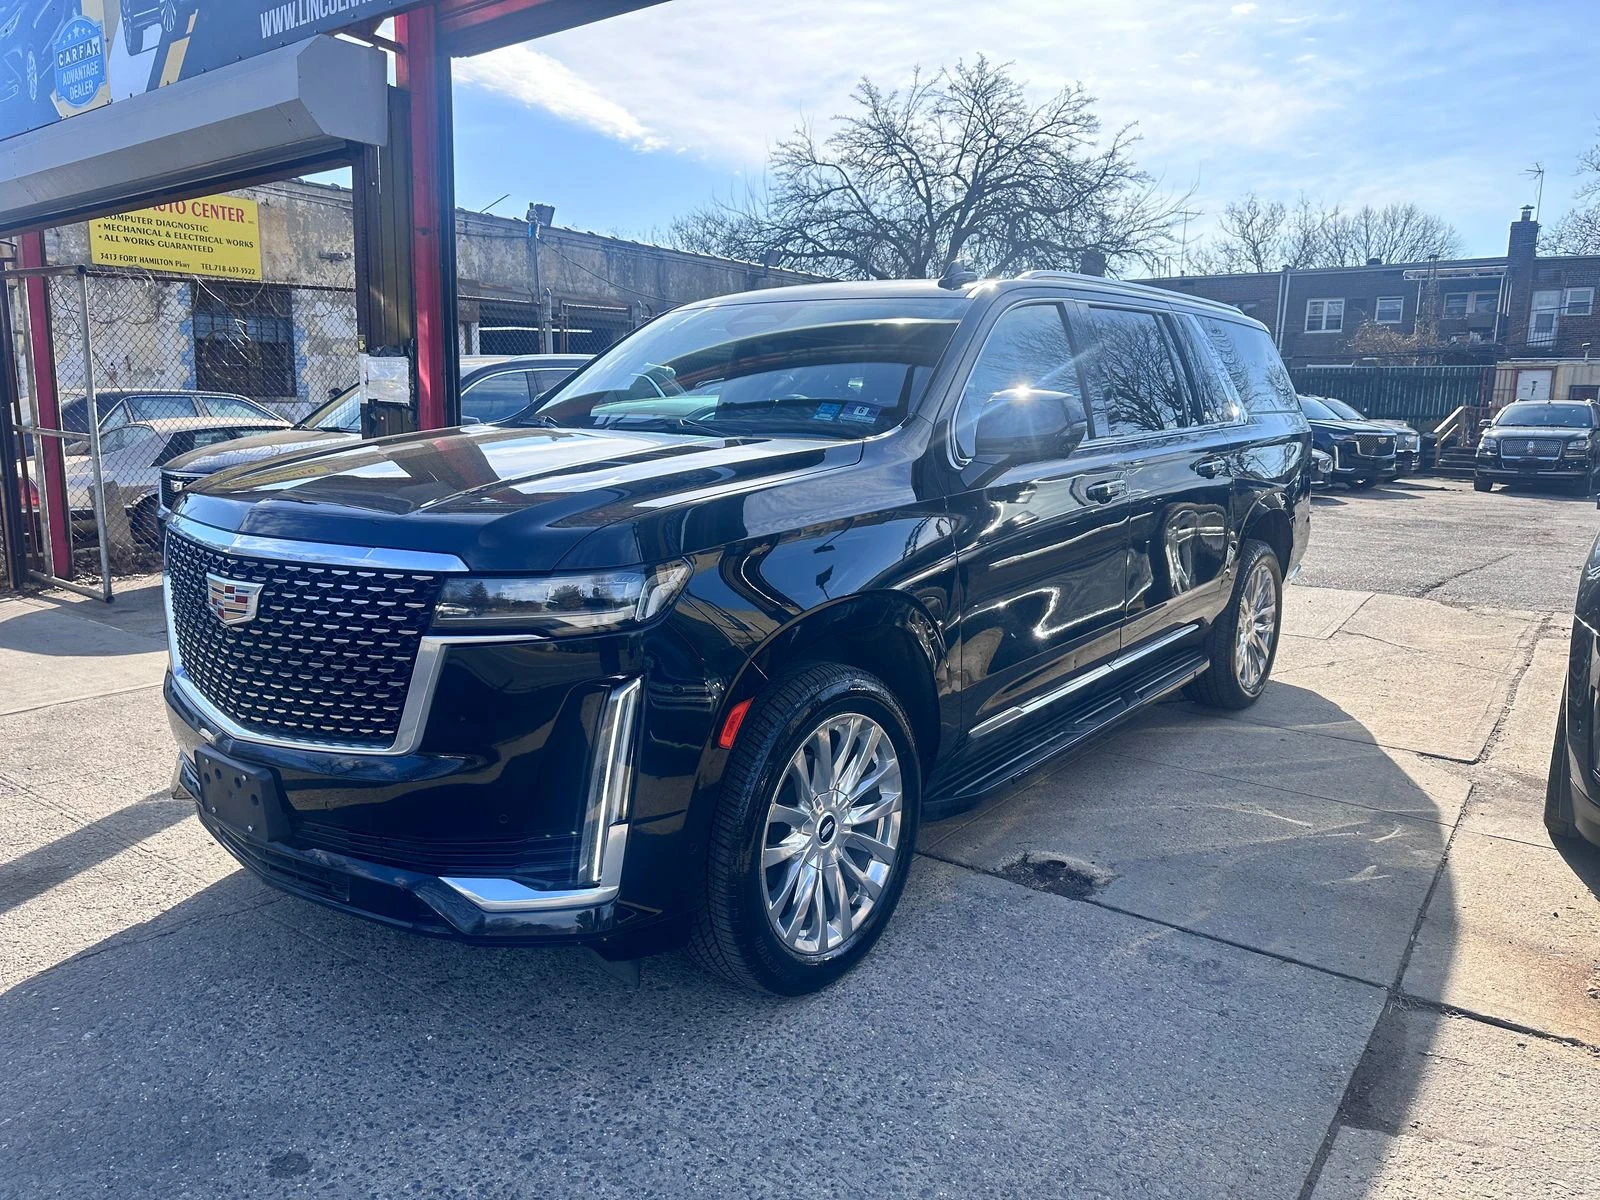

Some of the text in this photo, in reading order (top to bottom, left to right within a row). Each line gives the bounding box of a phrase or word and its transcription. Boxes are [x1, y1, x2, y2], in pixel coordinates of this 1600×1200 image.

[260, 0, 373, 39] WWW.LINCO
[57, 41, 100, 67] CARFAX
[62, 60, 99, 86] ADVANTAGE
[69, 79, 94, 100] DEALER
[152, 201, 245, 224] UTO CENTER
[103, 223, 254, 248] MECHANICAL & ELECTRICAL WORKS
[156, 219, 209, 233] DIAGNOSTIC
[103, 234, 214, 253] ALL WORKS GUARANTEED
[119, 254, 138, 263] FORT
[139, 256, 174, 266] HAMILTON
